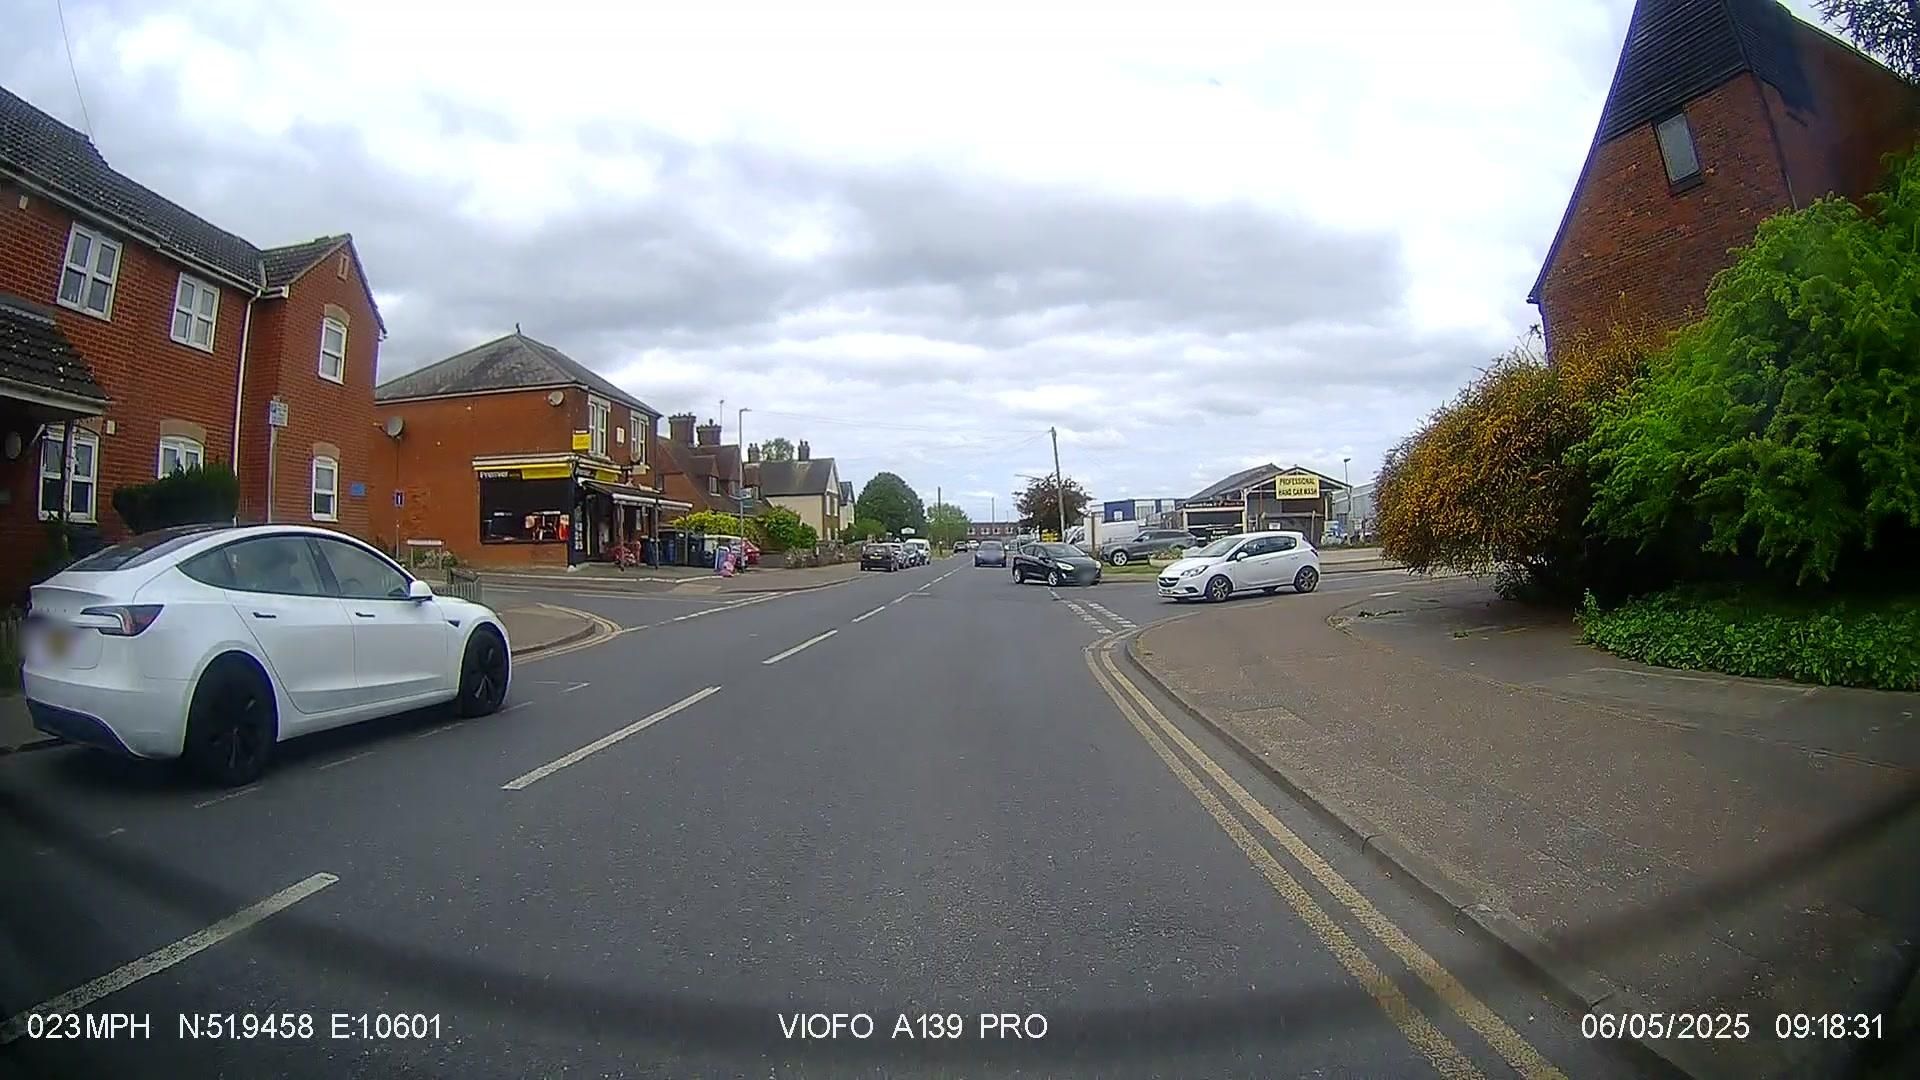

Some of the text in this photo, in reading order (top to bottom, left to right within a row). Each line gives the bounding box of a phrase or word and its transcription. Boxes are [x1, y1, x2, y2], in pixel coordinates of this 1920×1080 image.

[1279, 477, 1316, 486] PROFESSIONAL
[1279, 488, 1317, 496] HAND CAR WASH
